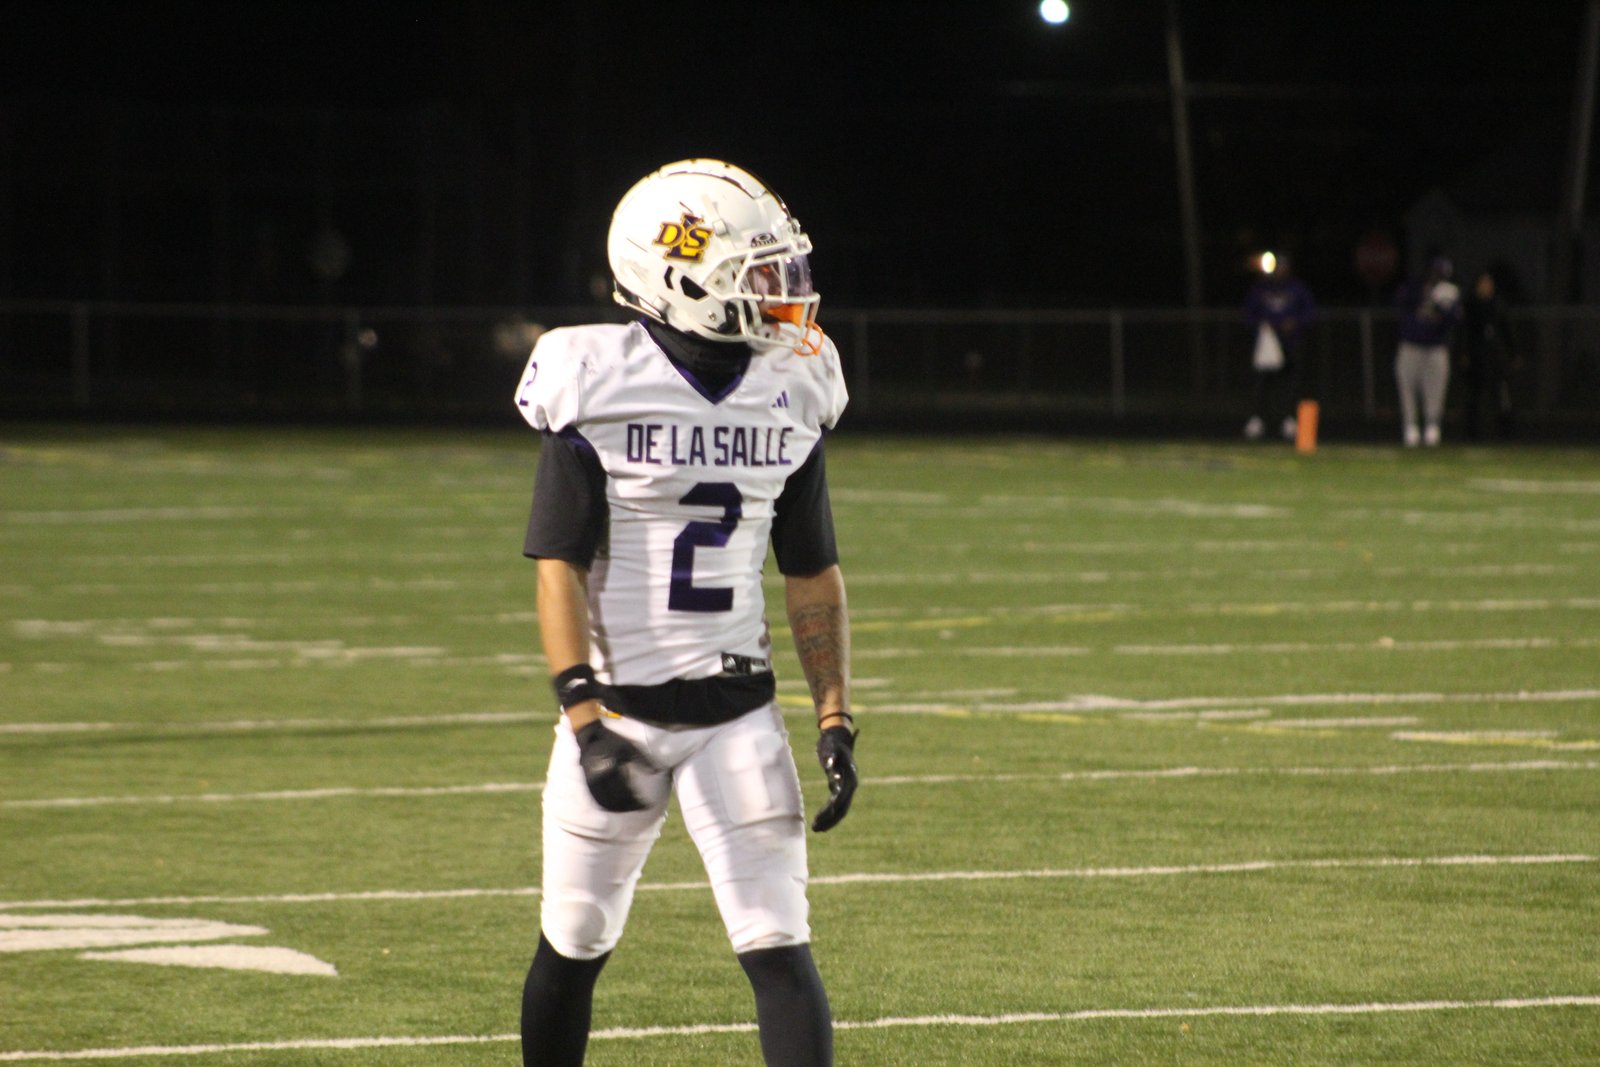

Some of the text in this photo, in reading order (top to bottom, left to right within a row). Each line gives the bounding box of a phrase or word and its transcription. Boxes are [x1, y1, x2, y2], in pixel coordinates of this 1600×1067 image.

[519, 361, 538, 407] 2
[627, 424, 793, 467] DE LA SALLE
[668, 482, 743, 612] 2
